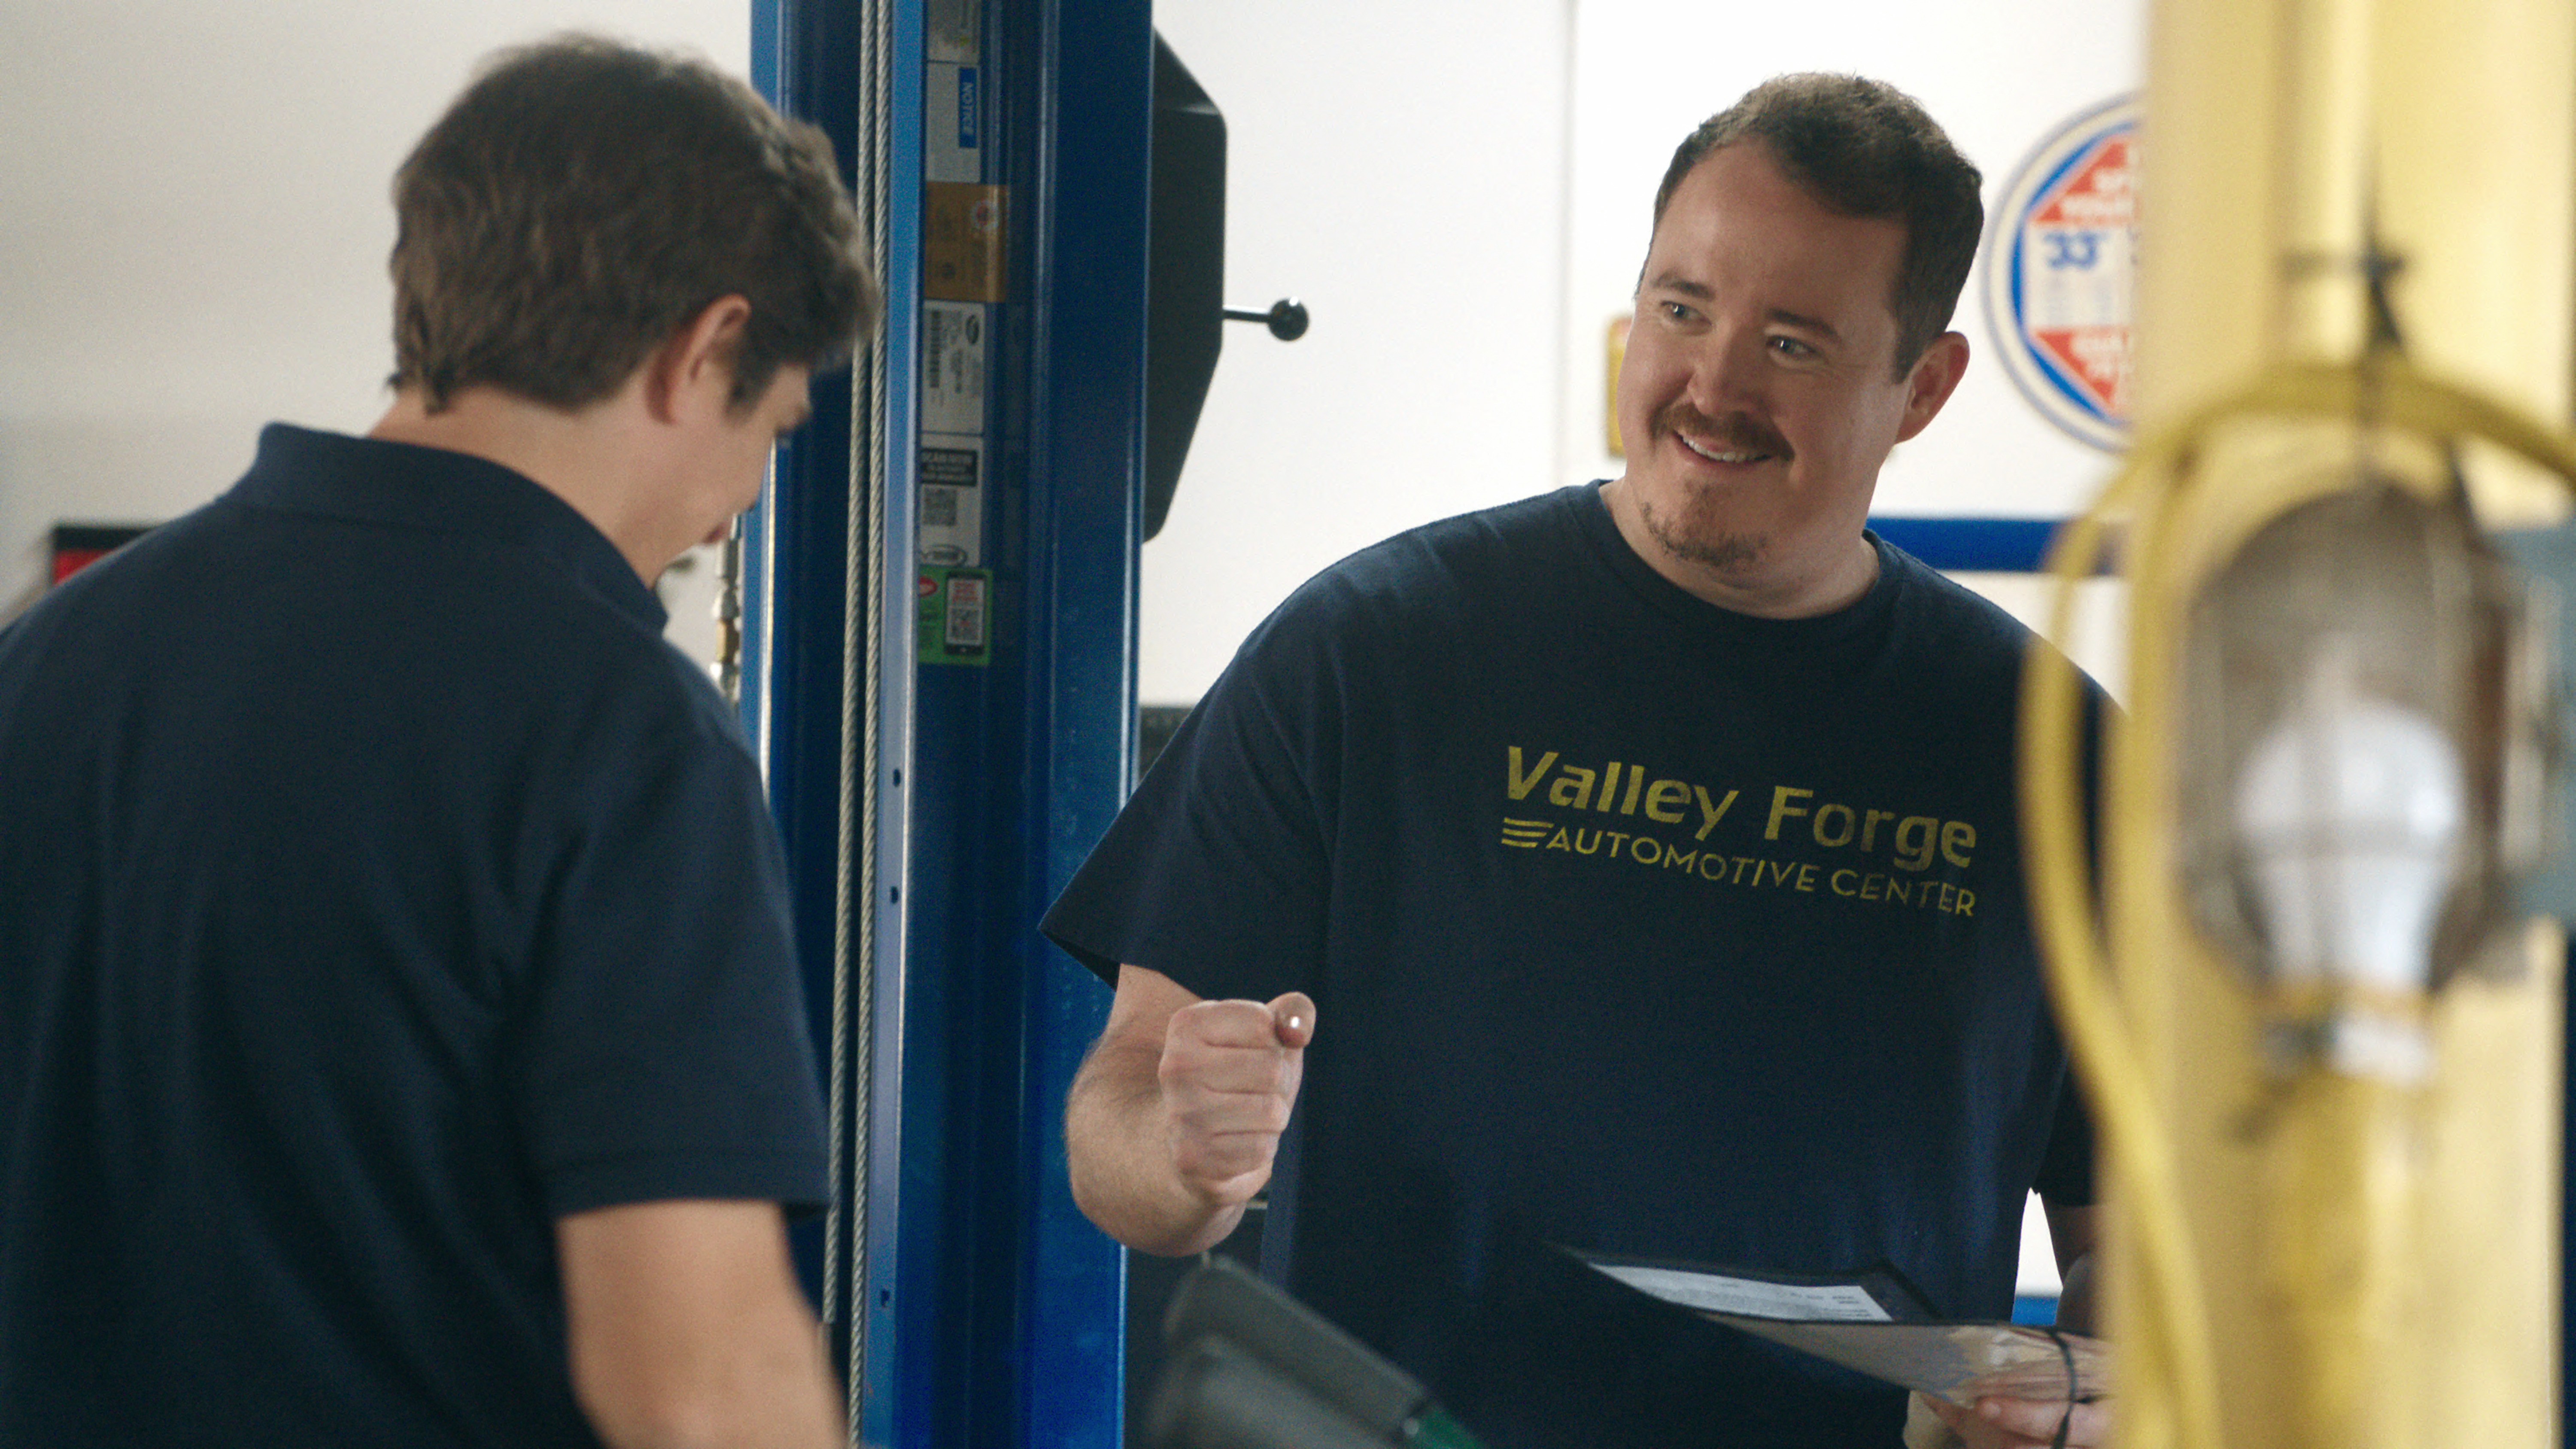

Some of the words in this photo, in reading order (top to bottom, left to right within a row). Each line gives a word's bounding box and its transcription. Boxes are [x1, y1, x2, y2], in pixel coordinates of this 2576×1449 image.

[962, 82, 975, 137] NOTICE
[1507, 745, 1740, 841] Valley
[1764, 785, 1977, 872] Forge
[1546, 826, 1820, 892] AUTOMOTIVE
[1831, 869, 1976, 917] CENTER
